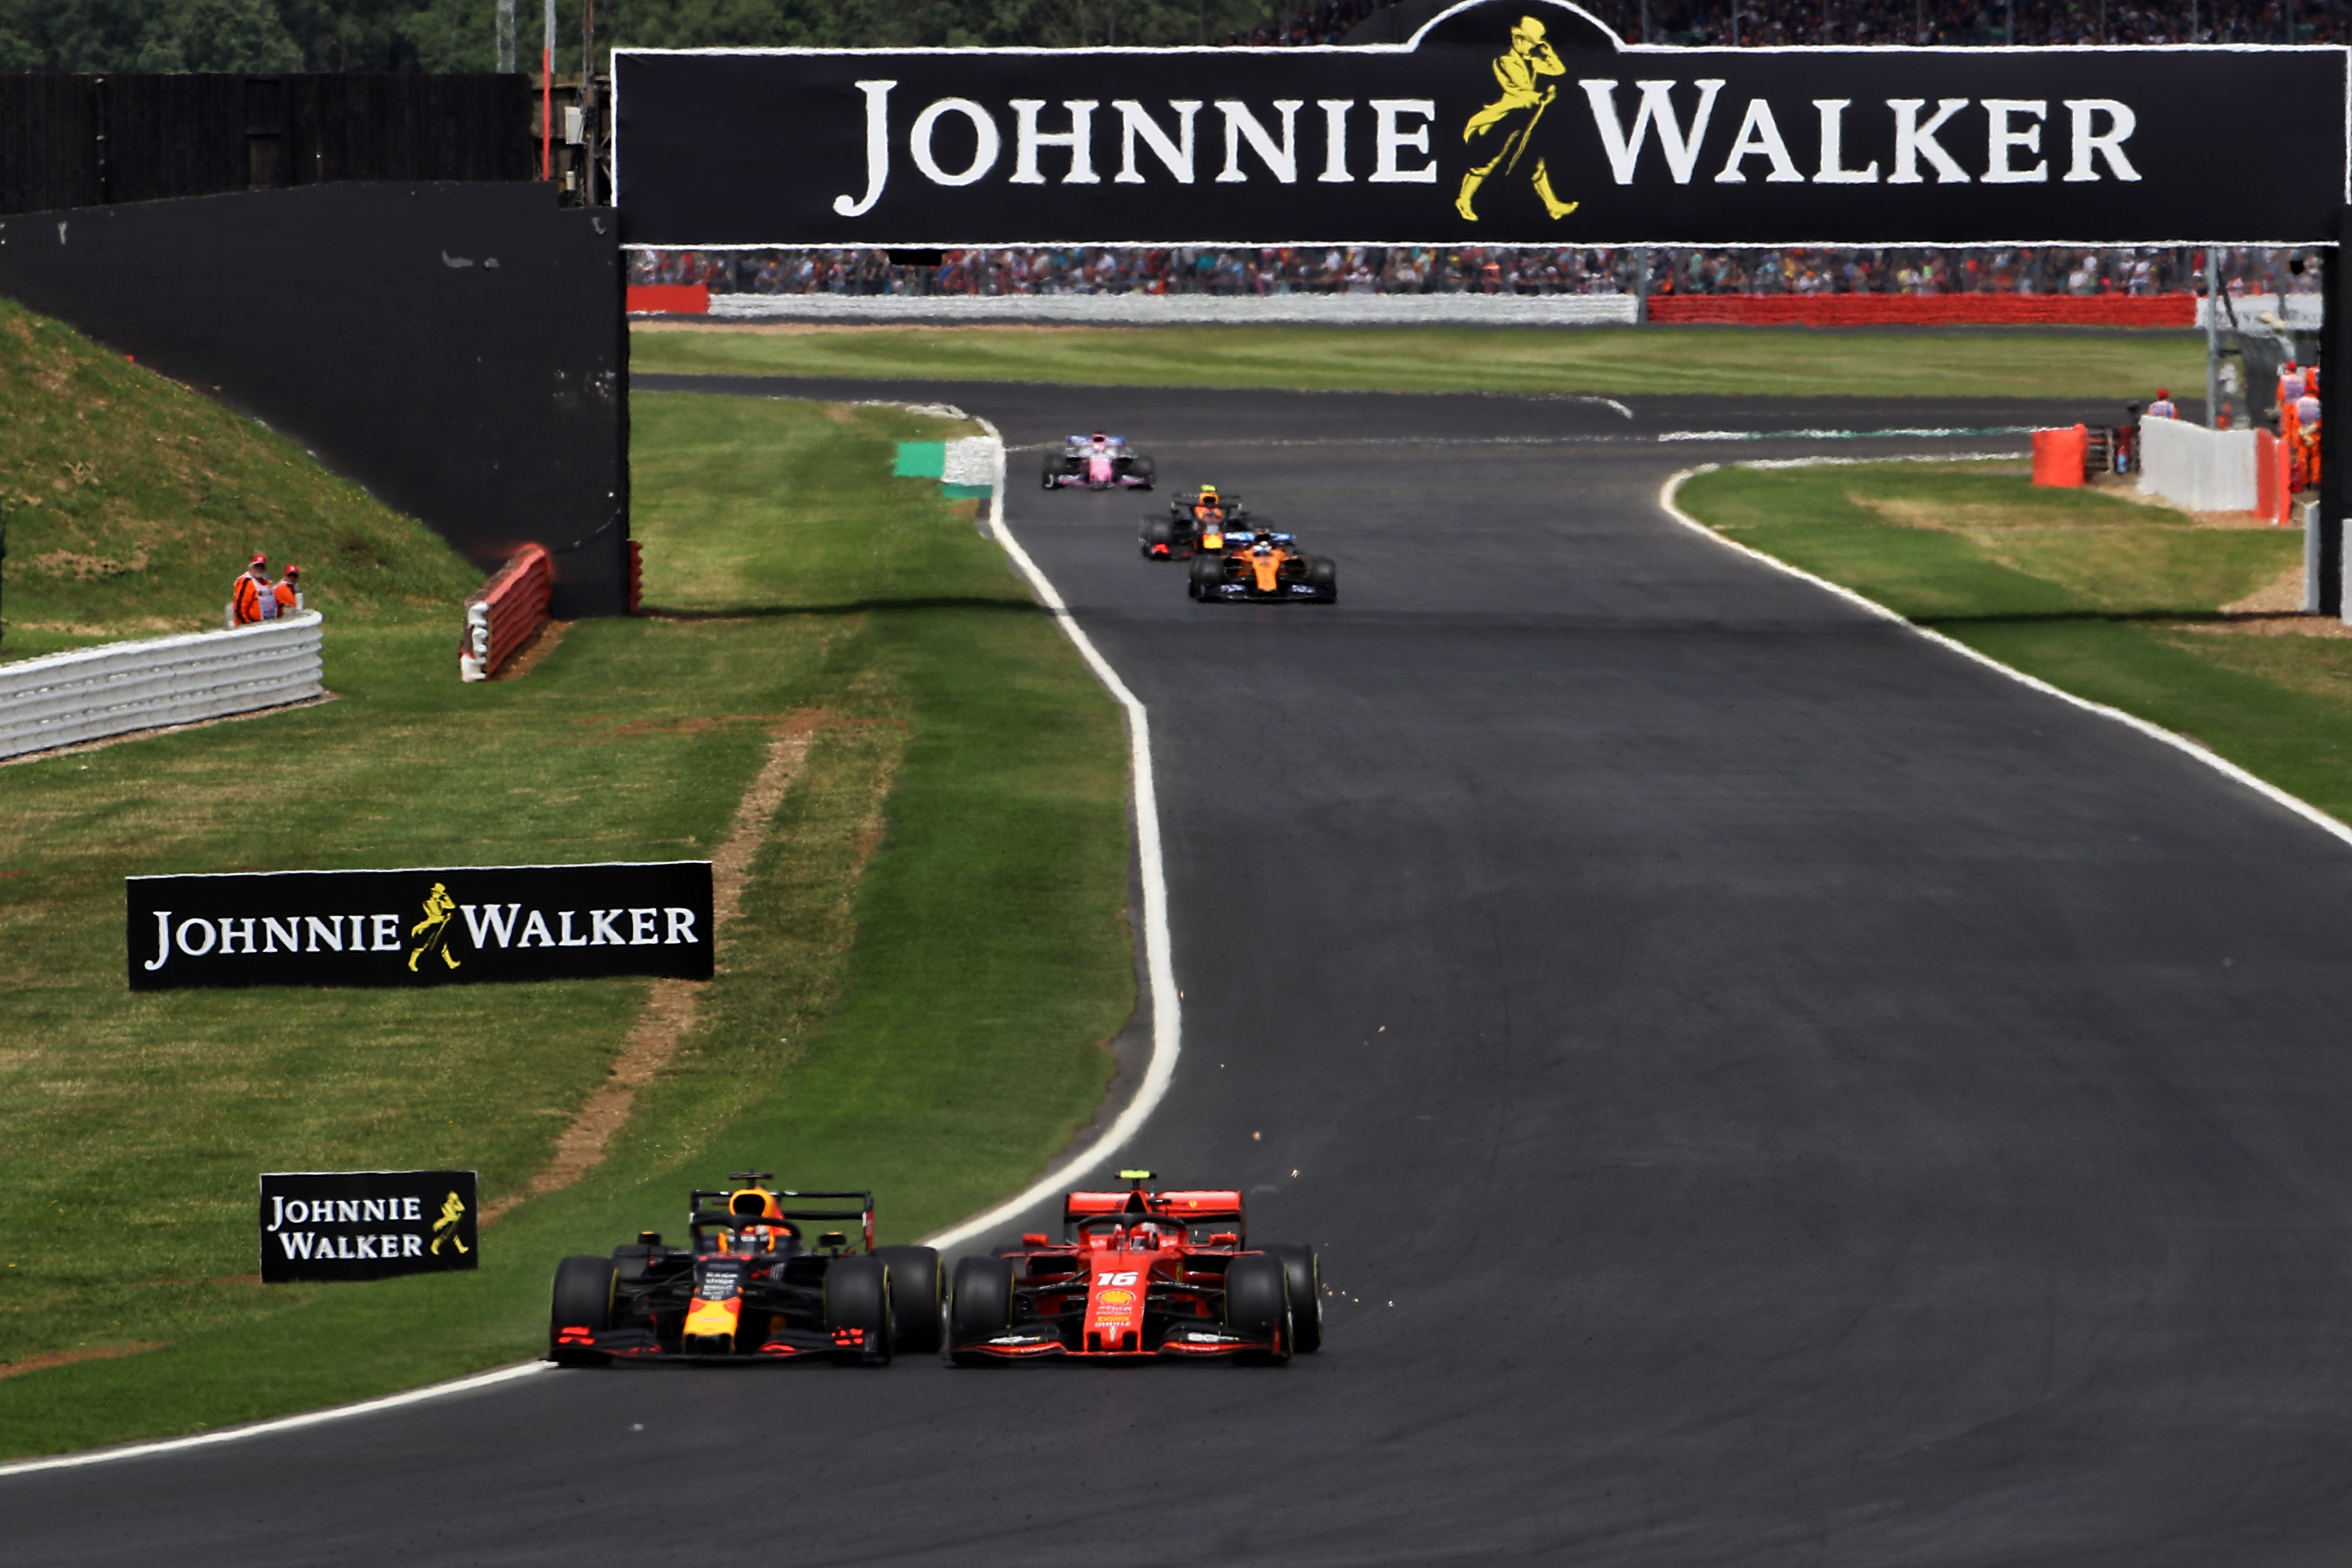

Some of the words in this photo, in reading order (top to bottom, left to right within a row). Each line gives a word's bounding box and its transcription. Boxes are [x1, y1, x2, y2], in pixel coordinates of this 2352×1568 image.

[833, 78, 1438, 218] JOHNNIE
[1577, 77, 2143, 186] WALKER
[144, 911, 401, 971] JOHNNIE
[459, 903, 699, 949] WALKER
[266, 1195, 422, 1232] JOHNNIE
[278, 1231, 423, 1260] WALKER
[1097, 1271, 1139, 1286] 16
